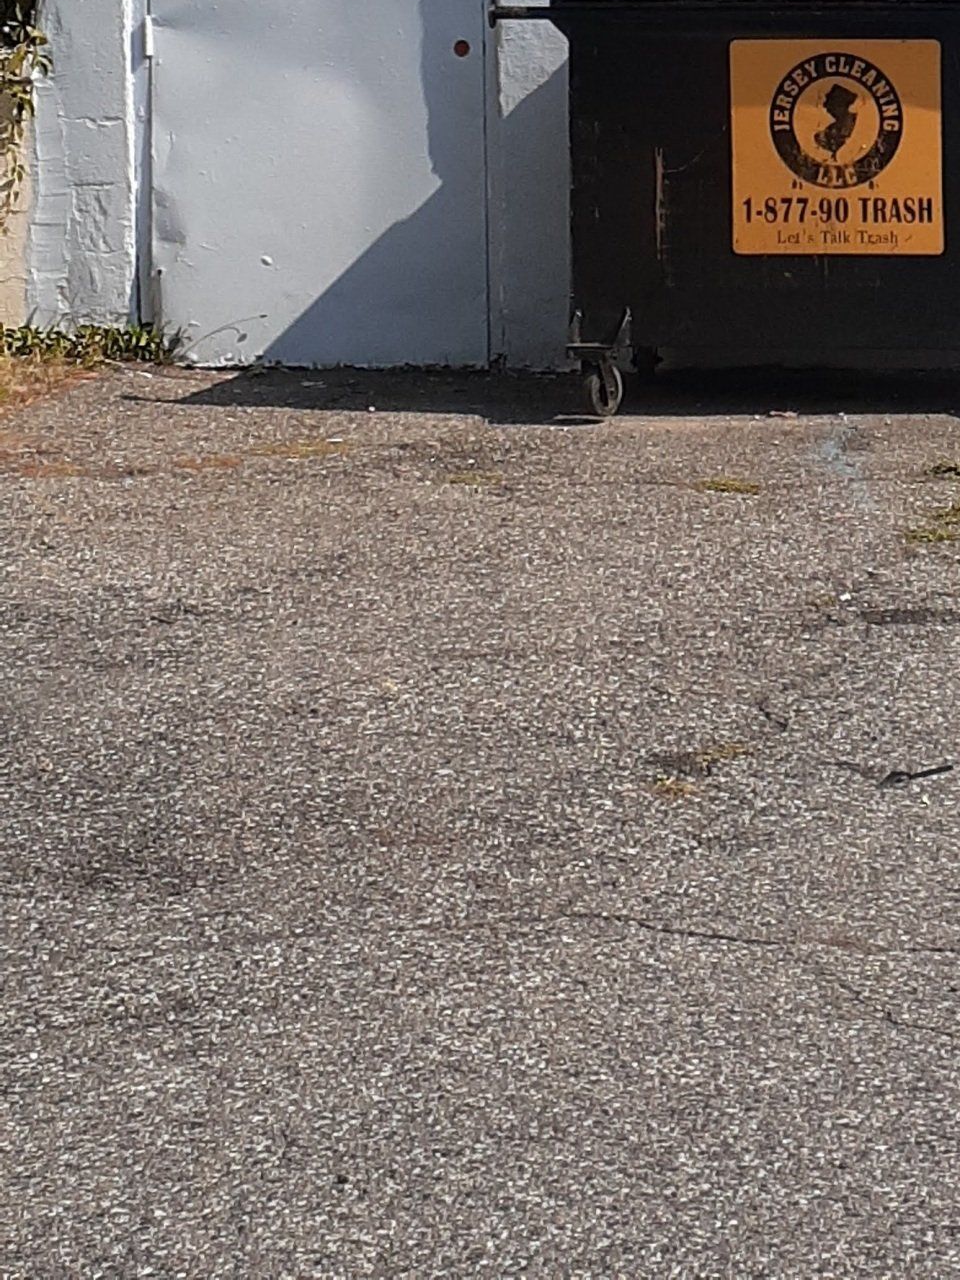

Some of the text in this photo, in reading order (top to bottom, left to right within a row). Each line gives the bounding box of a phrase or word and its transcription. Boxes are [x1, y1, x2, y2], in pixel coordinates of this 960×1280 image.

[773, 55, 900, 133] JERSEY CLEANING
[816, 167, 858, 187] LLC
[742, 196, 933, 224] 1-877-90 TRASH
[776, 229, 898, 245] Let's Talk Trash
